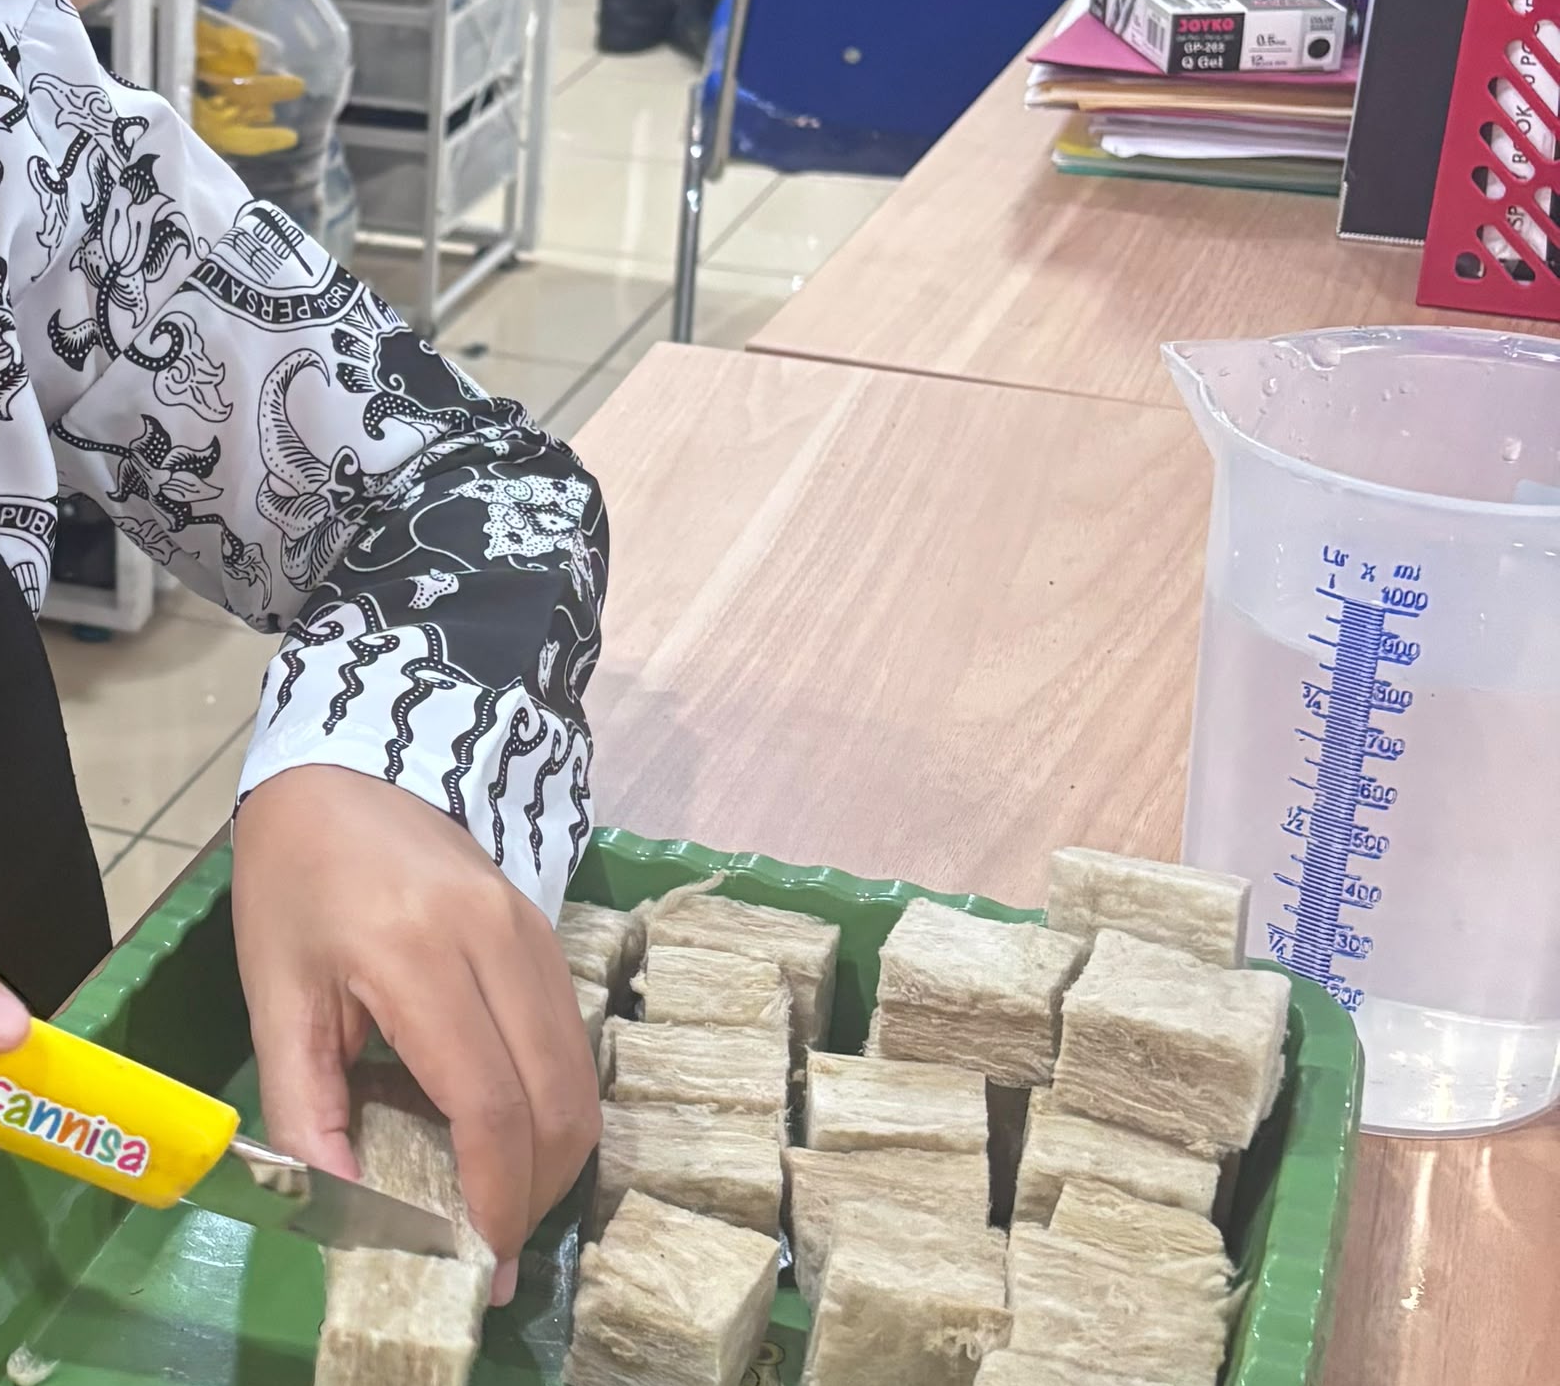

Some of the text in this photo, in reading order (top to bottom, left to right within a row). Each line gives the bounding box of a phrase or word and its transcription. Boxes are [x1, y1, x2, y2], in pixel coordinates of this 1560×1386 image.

[1178, 17, 1235, 33] JOYKO
[1381, 586, 1428, 611] 1000
[1366, 734, 1406, 756] 700
[1360, 783, 1398, 806] 600
[1351, 832, 1390, 855] 500
[1344, 882, 1382, 904] 400
[1336, 932, 1374, 954] 300
